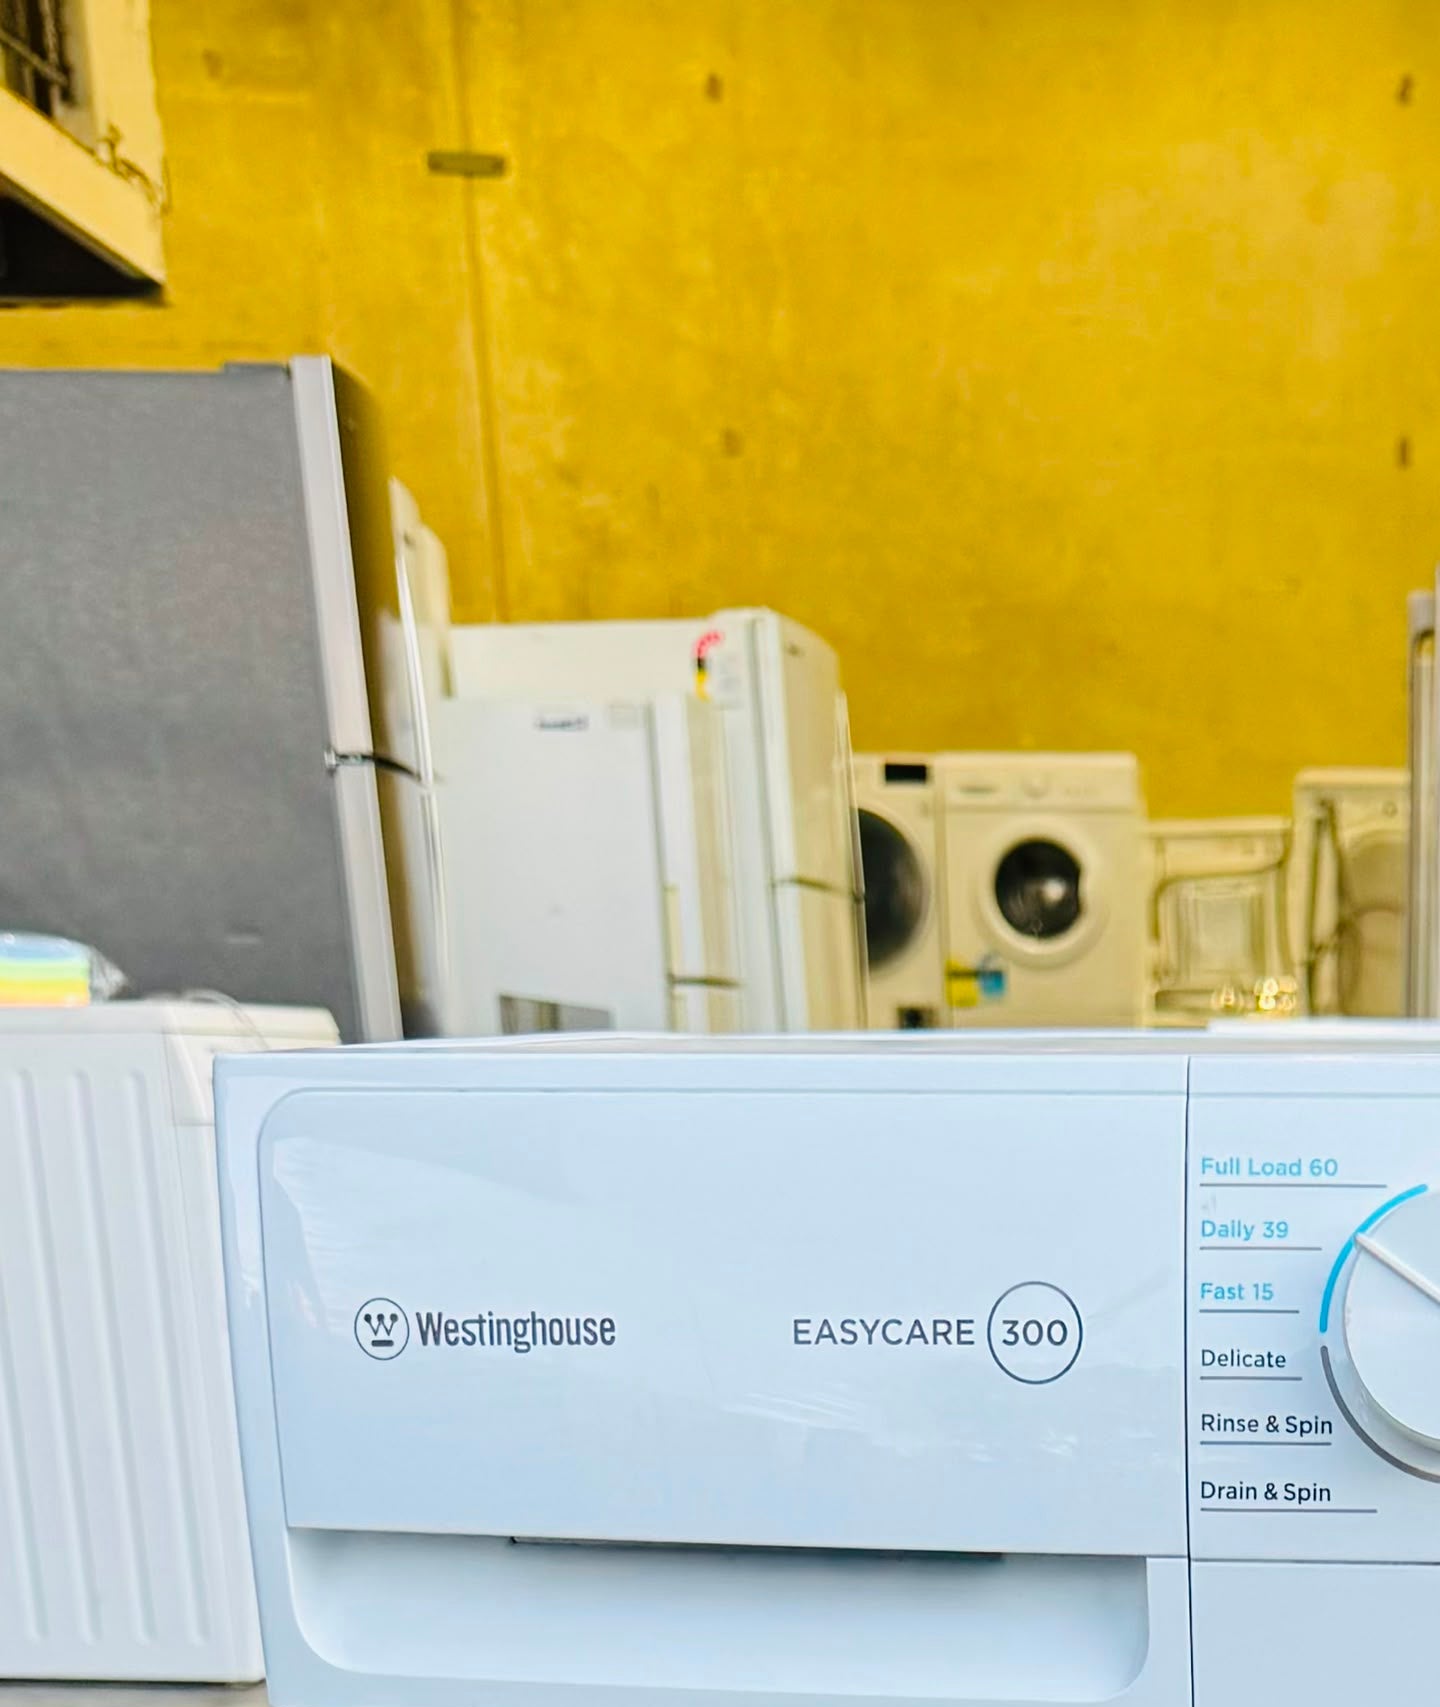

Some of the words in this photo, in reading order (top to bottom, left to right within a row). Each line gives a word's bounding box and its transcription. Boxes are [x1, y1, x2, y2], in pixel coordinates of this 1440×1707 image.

[1201, 1157, 1240, 1176] Full
[1248, 1158, 1301, 1176] Load
[1309, 1159, 1338, 1176] 60
[1201, 1220, 1255, 1241] Daily
[1263, 1221, 1288, 1238] 39
[1200, 1283, 1244, 1300] Fast
[1253, 1284, 1273, 1300] 15
[416, 1311, 616, 1353] Westinghouse
[793, 1318, 975, 1345] EASYCARE
[1002, 1320, 1068, 1346] 300
[1201, 1349, 1286, 1368] Delicate
[1201, 1414, 1259, 1432] Rinse
[1266, 1415, 1279, 1433] &
[1285, 1415, 1332, 1437] Spin
[1201, 1481, 1257, 1500] Drain
[1264, 1483, 1277, 1500] &
[1284, 1482, 1331, 1504] Spin
